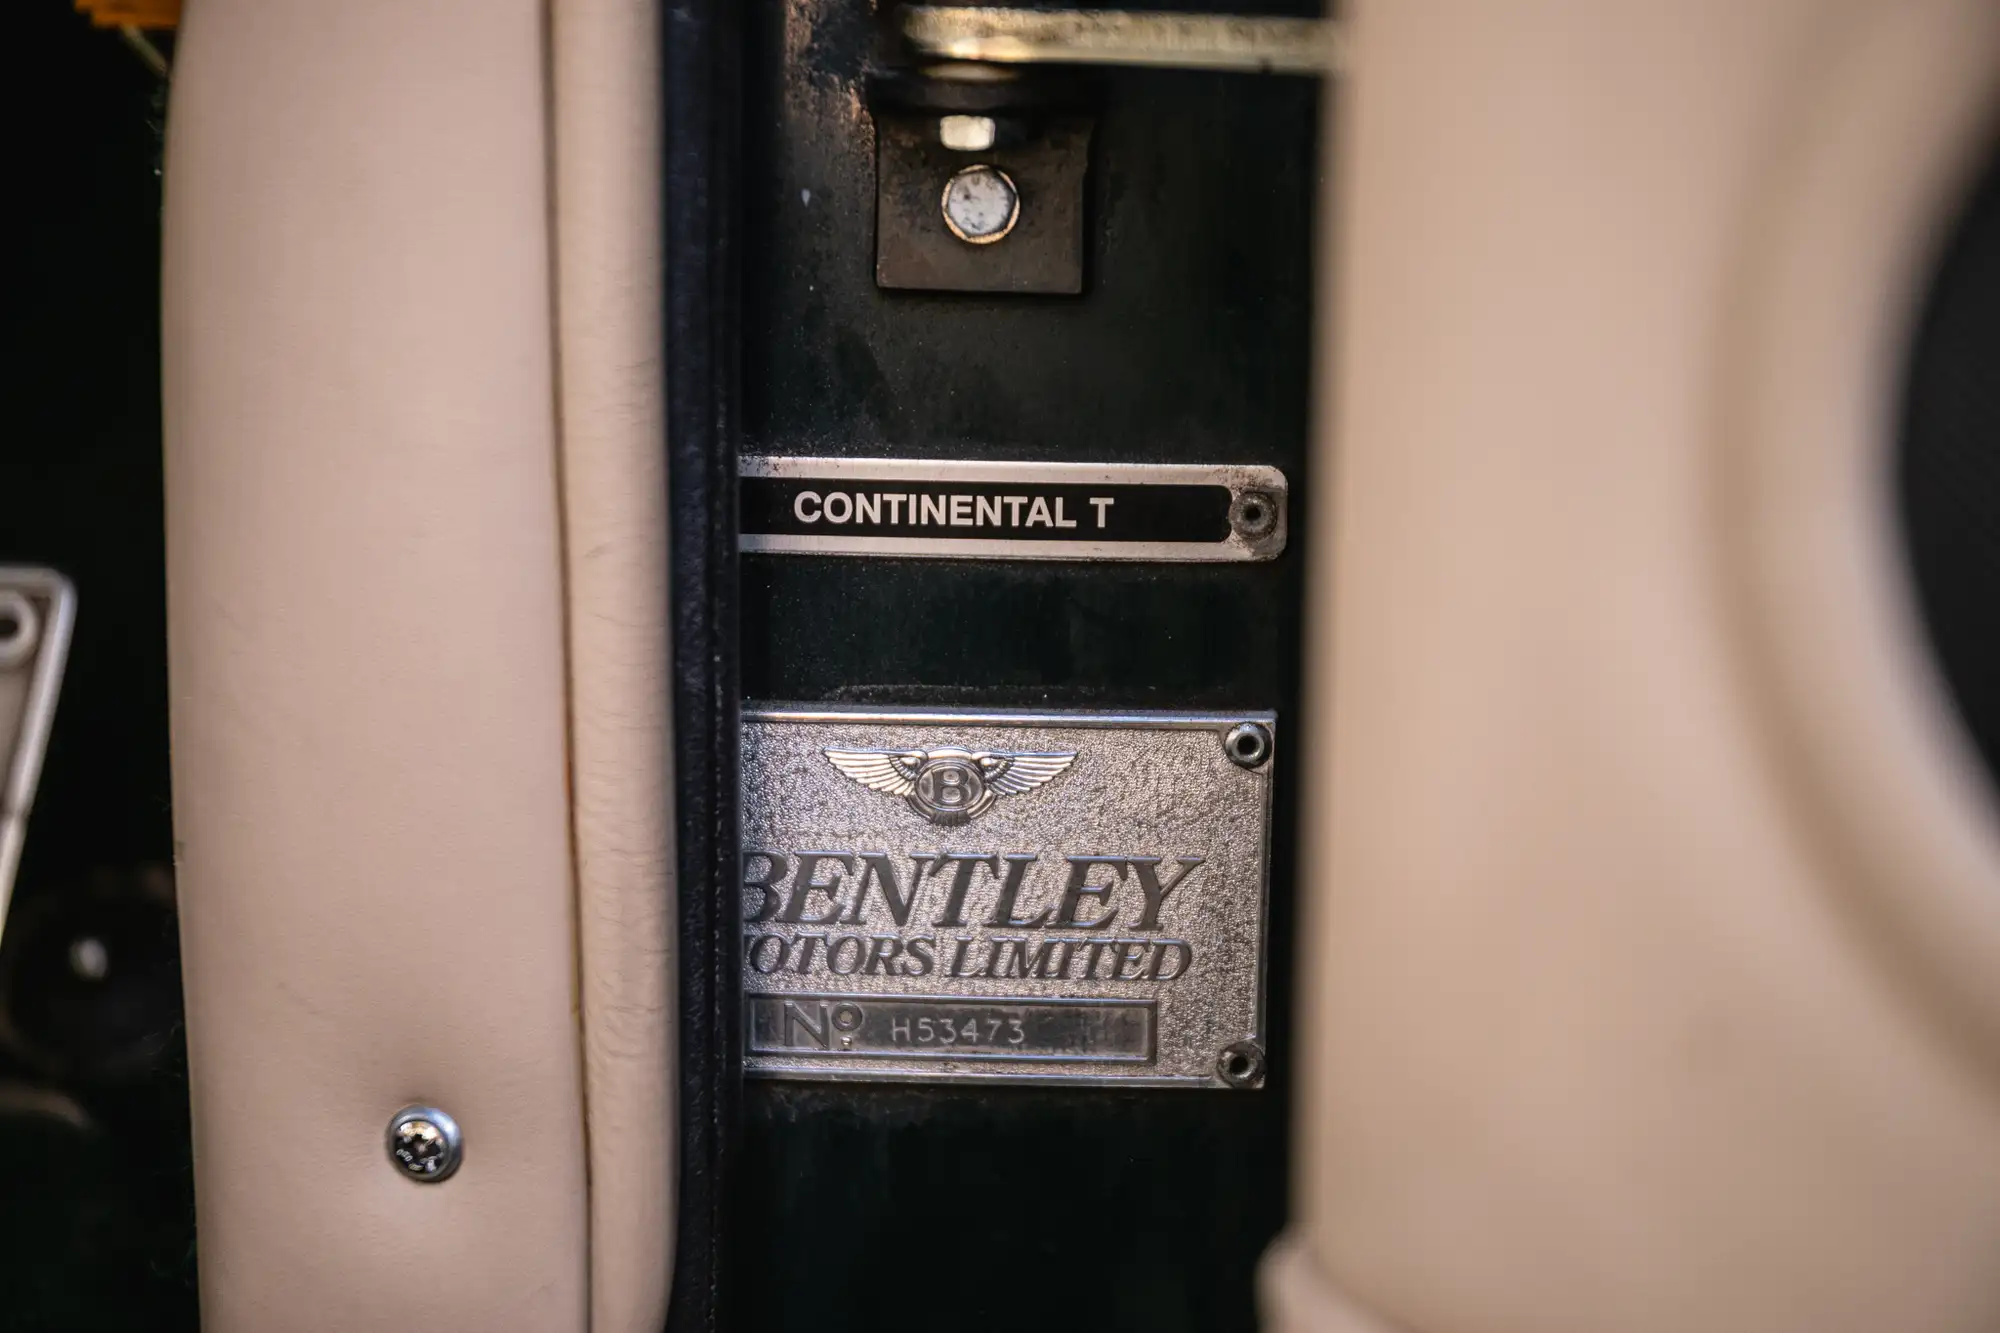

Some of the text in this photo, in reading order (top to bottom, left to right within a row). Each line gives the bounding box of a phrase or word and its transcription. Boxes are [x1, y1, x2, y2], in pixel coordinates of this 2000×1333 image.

[793, 490, 1115, 529] CONTINENTAL T
[931, 766, 971, 806] B
[742, 850, 1206, 931] BENTLEY
[742, 931, 1193, 982] OTORS LIMITED
[890, 1017, 1027, 1045] H53473
